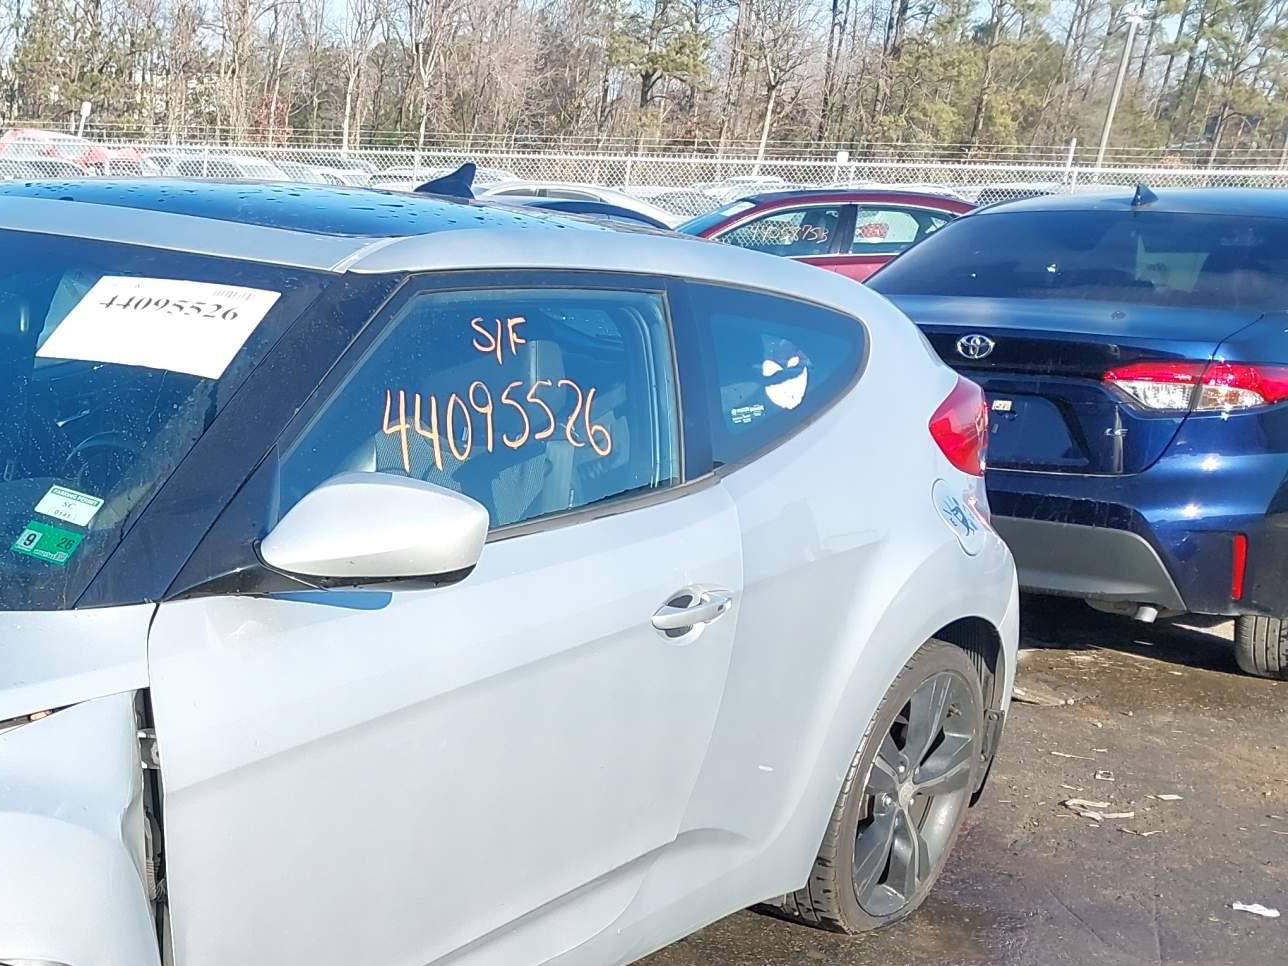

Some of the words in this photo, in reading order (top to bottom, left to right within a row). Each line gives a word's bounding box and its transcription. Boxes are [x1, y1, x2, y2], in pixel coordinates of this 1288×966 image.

[99, 294, 239, 321] 44095526
[382, 379, 613, 473] 44095526
[23, 533, 37, 546] 9
